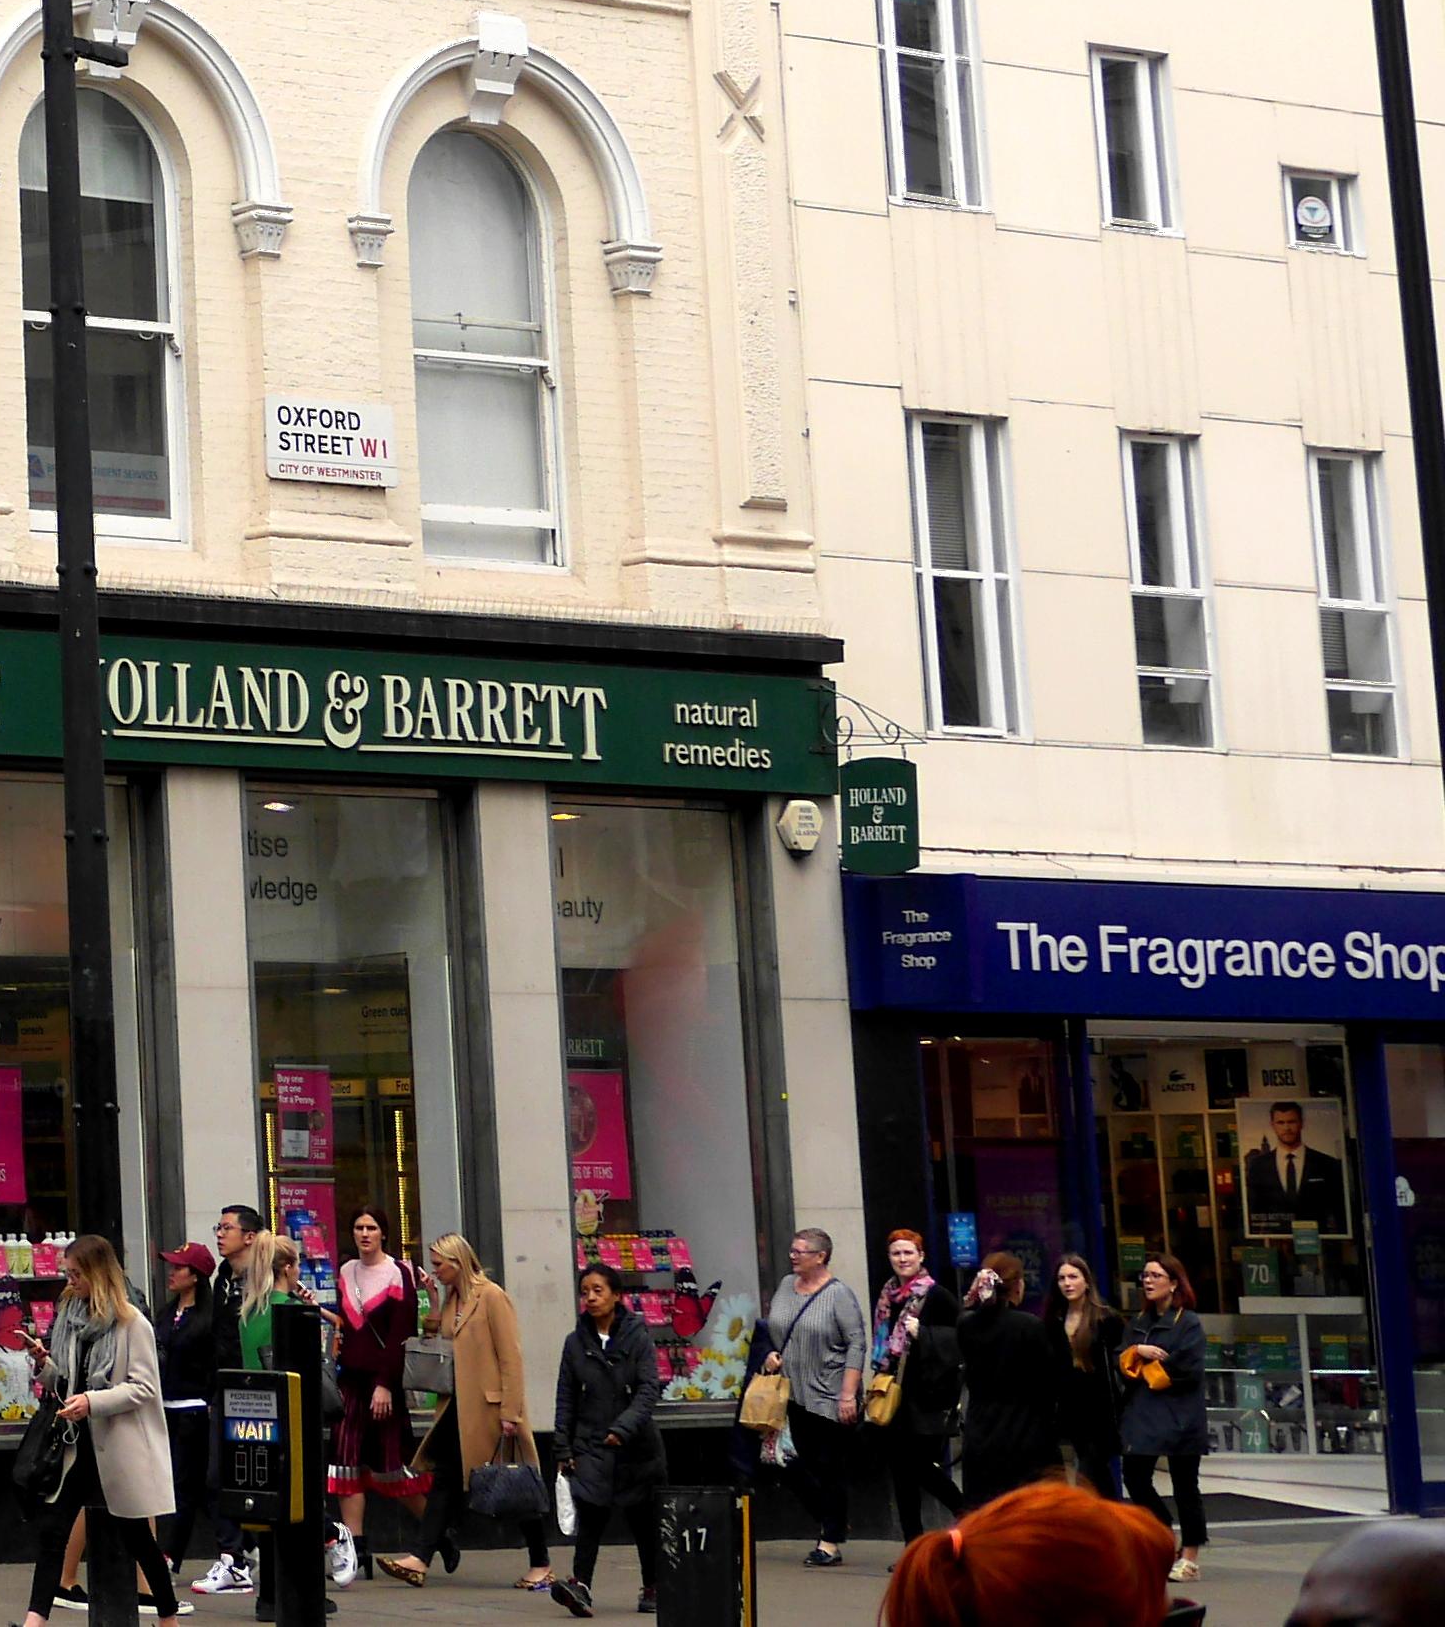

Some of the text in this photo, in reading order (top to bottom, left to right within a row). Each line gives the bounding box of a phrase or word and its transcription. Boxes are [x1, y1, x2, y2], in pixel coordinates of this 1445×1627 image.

[277, 405, 361, 431] OXFORD
[279, 431, 354, 456] STREET
[279, 463, 382, 482] CITY OF WESTMINSTER
[98, 656, 607, 761] OLLAND & BARRETT
[674, 697, 758, 730] natural
[663, 736, 772, 770] remedies
[849, 787, 906, 807] HOLLAND
[872, 805, 884, 823] &
[850, 825, 906, 845] BARRETT
[902, 909, 929, 923] The
[882, 929, 952, 947] Fragrance
[901, 953, 937, 969] Shop
[996, 921, 1337, 989] The Fragrance
[277, 1074, 289, 1083] Buy
[1161, 1082, 1195, 1092] LACOSTE
[1262, 1069, 1296, 1087] DIESEL
[280, 1186, 294, 1196] Buy
[1248, 1264, 1269, 1284] 70
[1244, 1385, 1257, 1398] 70
[234, 1421, 273, 1441] WAIT
[1246, 1432, 1261, 1446] 70
[682, 1528, 707, 1552] 17
